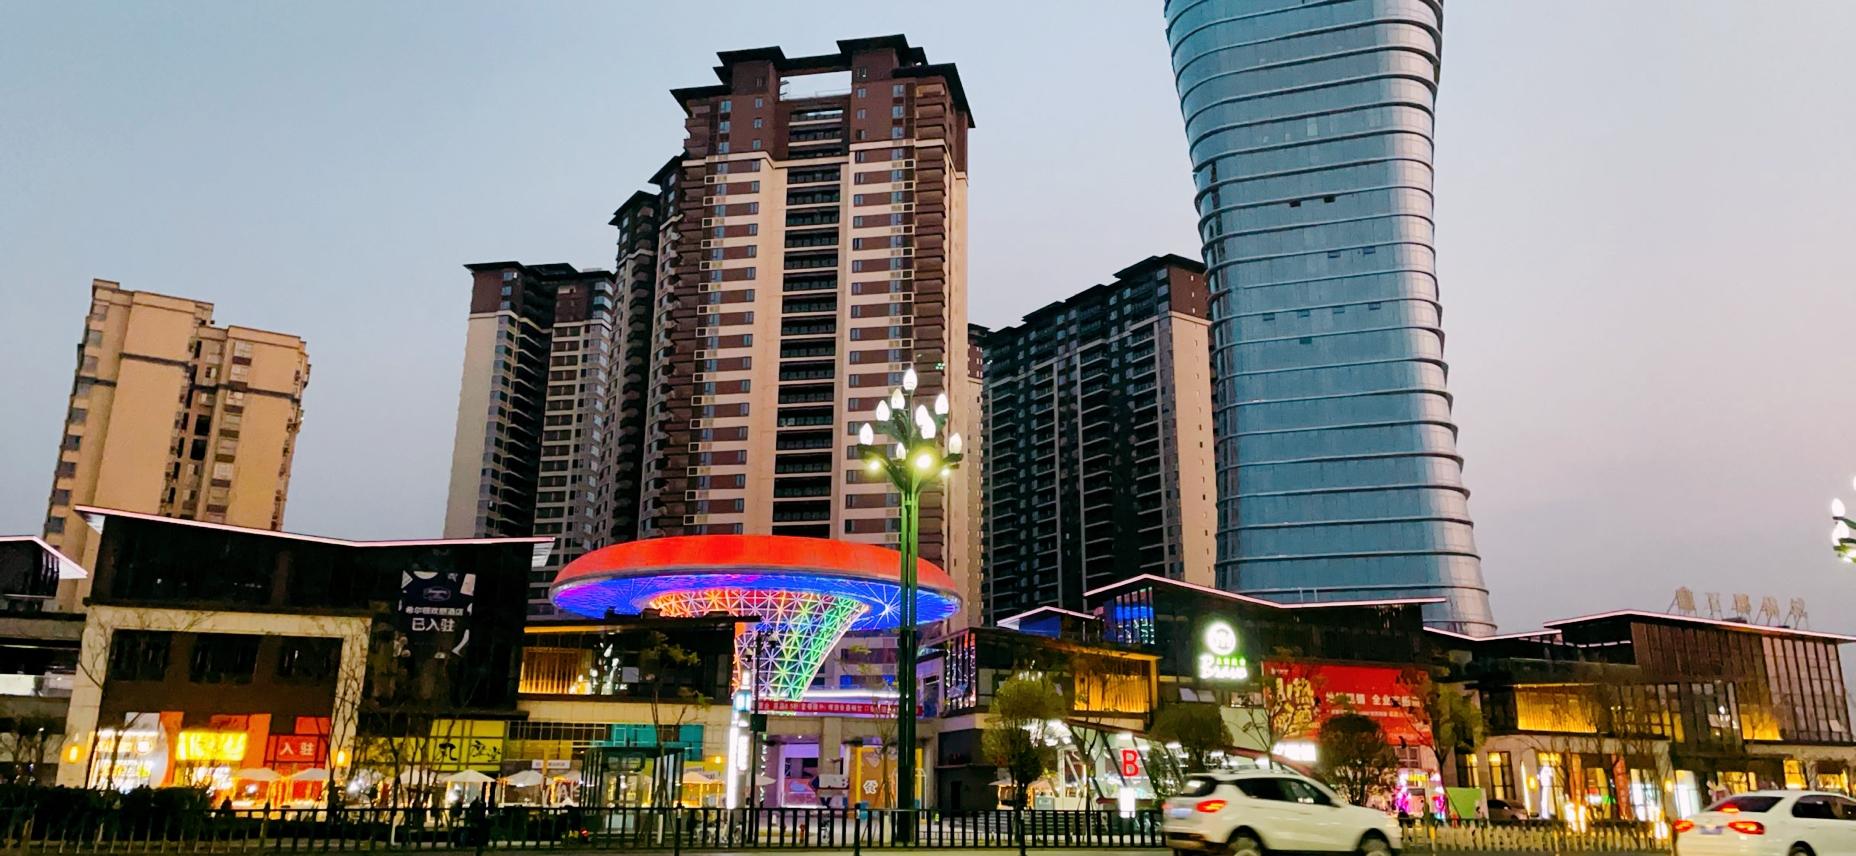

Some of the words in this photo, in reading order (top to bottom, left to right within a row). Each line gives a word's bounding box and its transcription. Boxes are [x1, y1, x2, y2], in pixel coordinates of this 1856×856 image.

[411, 617, 456, 632] 已入驻
[279, 741, 316, 756] 入驻
[1121, 749, 1139, 777] B
